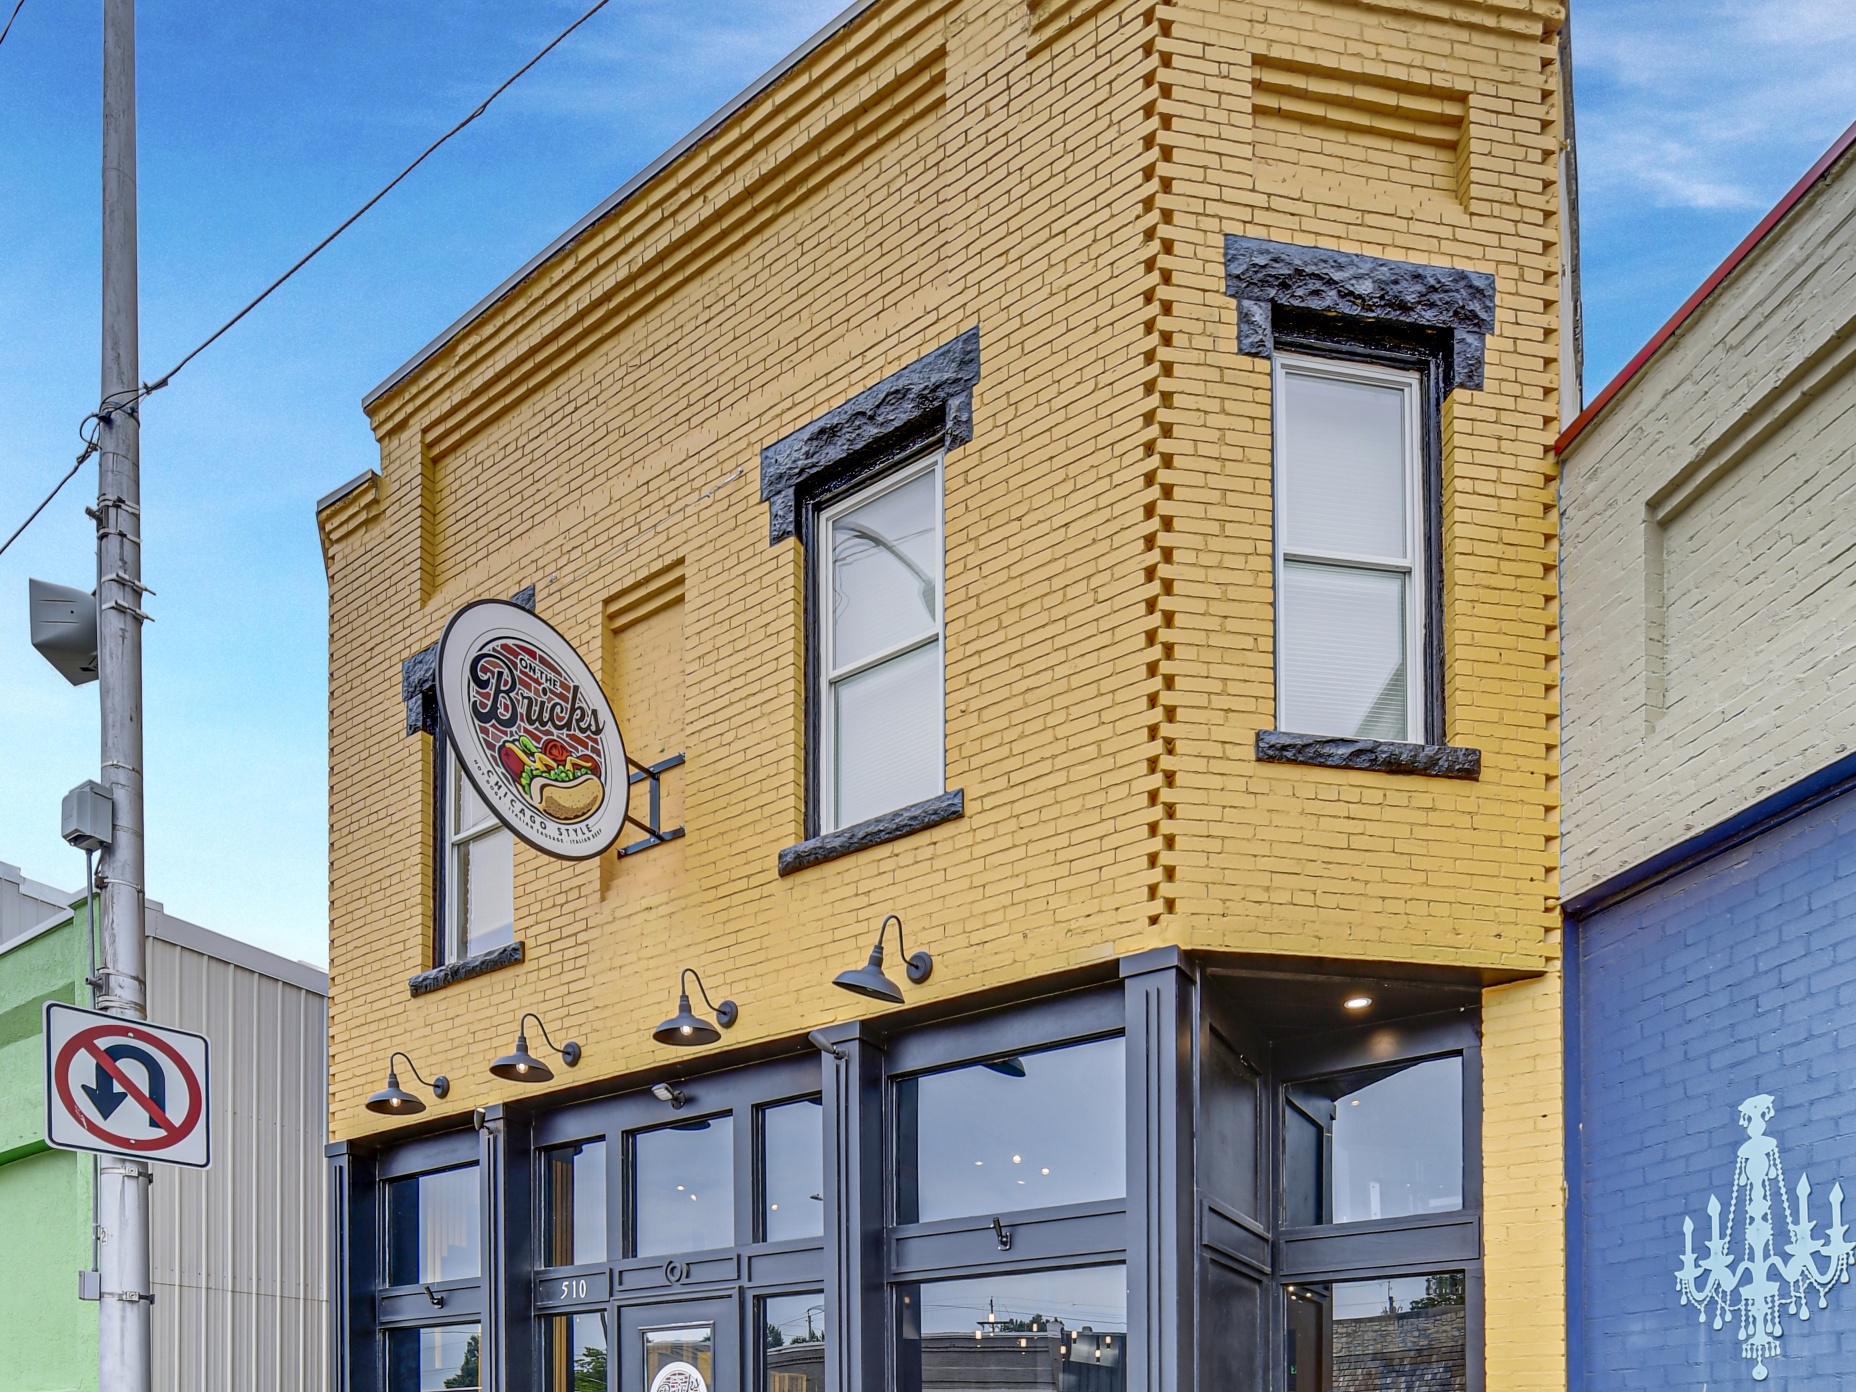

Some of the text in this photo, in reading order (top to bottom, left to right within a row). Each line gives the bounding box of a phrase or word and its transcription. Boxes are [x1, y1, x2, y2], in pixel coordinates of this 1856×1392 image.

[469, 653, 605, 736] Bricks
[519, 657, 559, 690] ON THE
[474, 760, 485, 776] HOT
[508, 807, 534, 830] ITALIAN
[536, 828, 564, 843] SAUSAGE
[569, 836, 591, 845] ITALIAN
[486, 769, 592, 837] CHICAGO STYLE
[560, 1280, 587, 1299] 510
